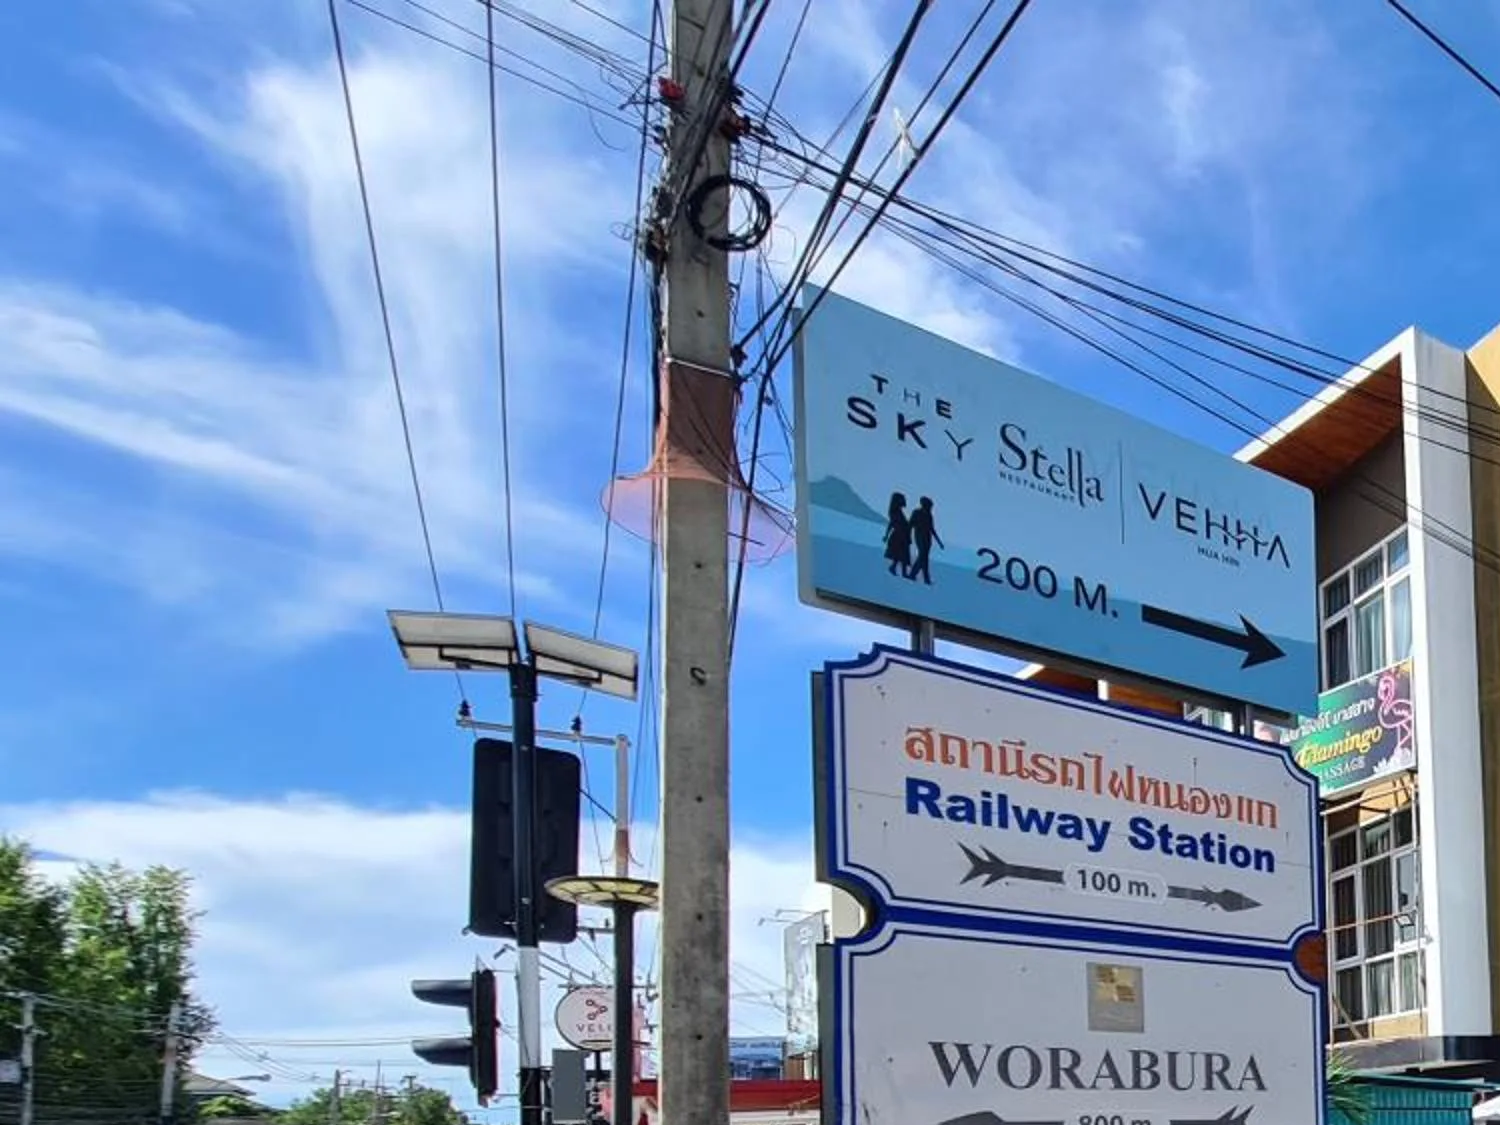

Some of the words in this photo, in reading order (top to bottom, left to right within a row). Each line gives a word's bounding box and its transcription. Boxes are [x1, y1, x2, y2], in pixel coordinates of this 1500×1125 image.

[847, 396, 974, 461] SKY
[870, 373, 951, 421] THE
[999, 423, 1105, 507] Stella
[976, 547, 1058, 599] 200
[1073, 576, 1119, 619] M.
[905, 776, 1112, 853] Railway
[1127, 816, 1276, 873] Station
[1077, 869, 1123, 897] 100
[1128, 876, 1158, 898] m.
[927, 1040, 1268, 1092] WORABURA
